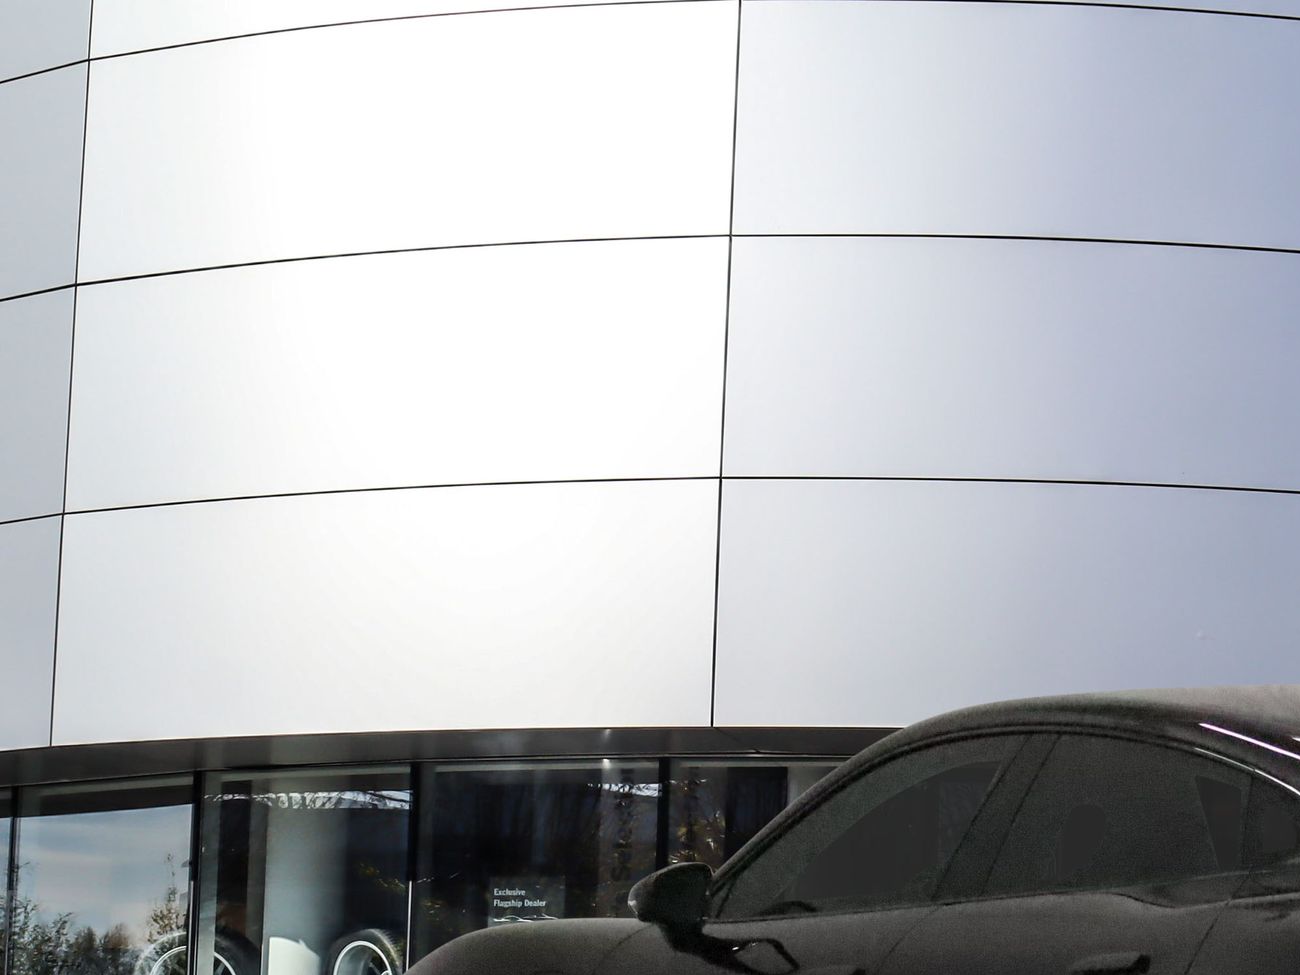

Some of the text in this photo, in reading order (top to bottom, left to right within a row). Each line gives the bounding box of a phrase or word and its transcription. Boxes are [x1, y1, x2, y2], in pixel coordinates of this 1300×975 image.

[493, 888, 526, 896] Exclusive
[493, 899, 546, 908] Flagship Dealer
